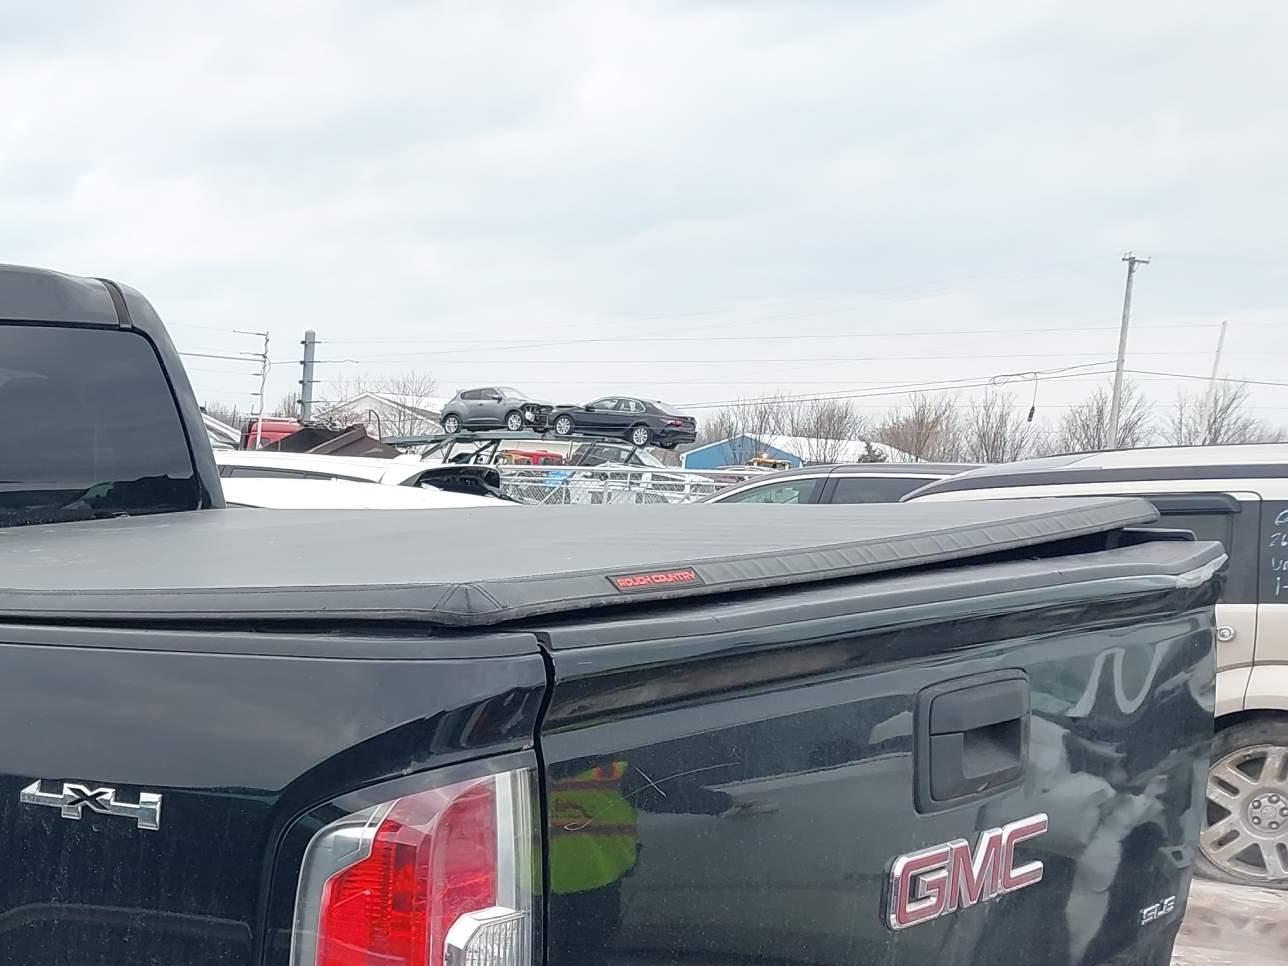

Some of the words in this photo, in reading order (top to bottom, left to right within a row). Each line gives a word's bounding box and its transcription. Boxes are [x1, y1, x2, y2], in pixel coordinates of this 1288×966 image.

[616, 574, 652, 588] ROUGH
[651, 570, 697, 584] COUNTRY
[886, 812, 1049, 931] GMC
[1140, 895, 1176, 926] SLE
